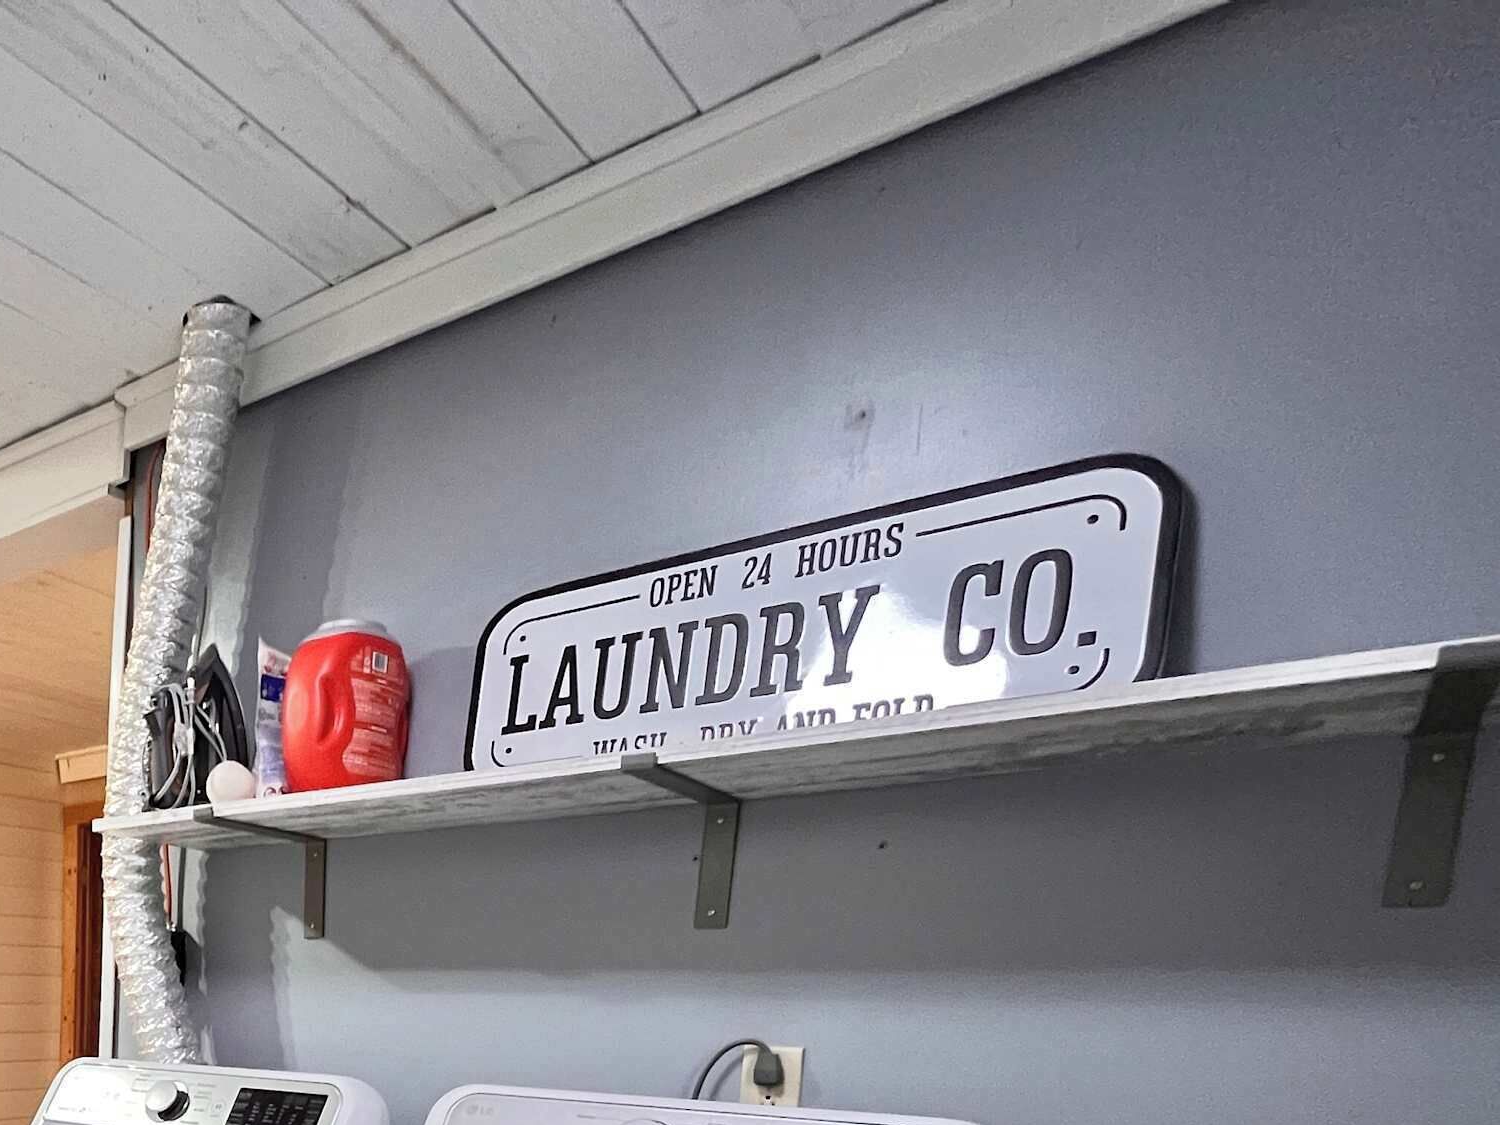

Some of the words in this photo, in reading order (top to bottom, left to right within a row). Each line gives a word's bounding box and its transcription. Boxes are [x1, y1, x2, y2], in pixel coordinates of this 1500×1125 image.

[649, 564, 718, 608] OPEN
[741, 552, 772, 590] 24
[794, 522, 904, 578] HOURS
[501, 584, 881, 735] LAUNDRY
[943, 548, 1098, 668] CO.
